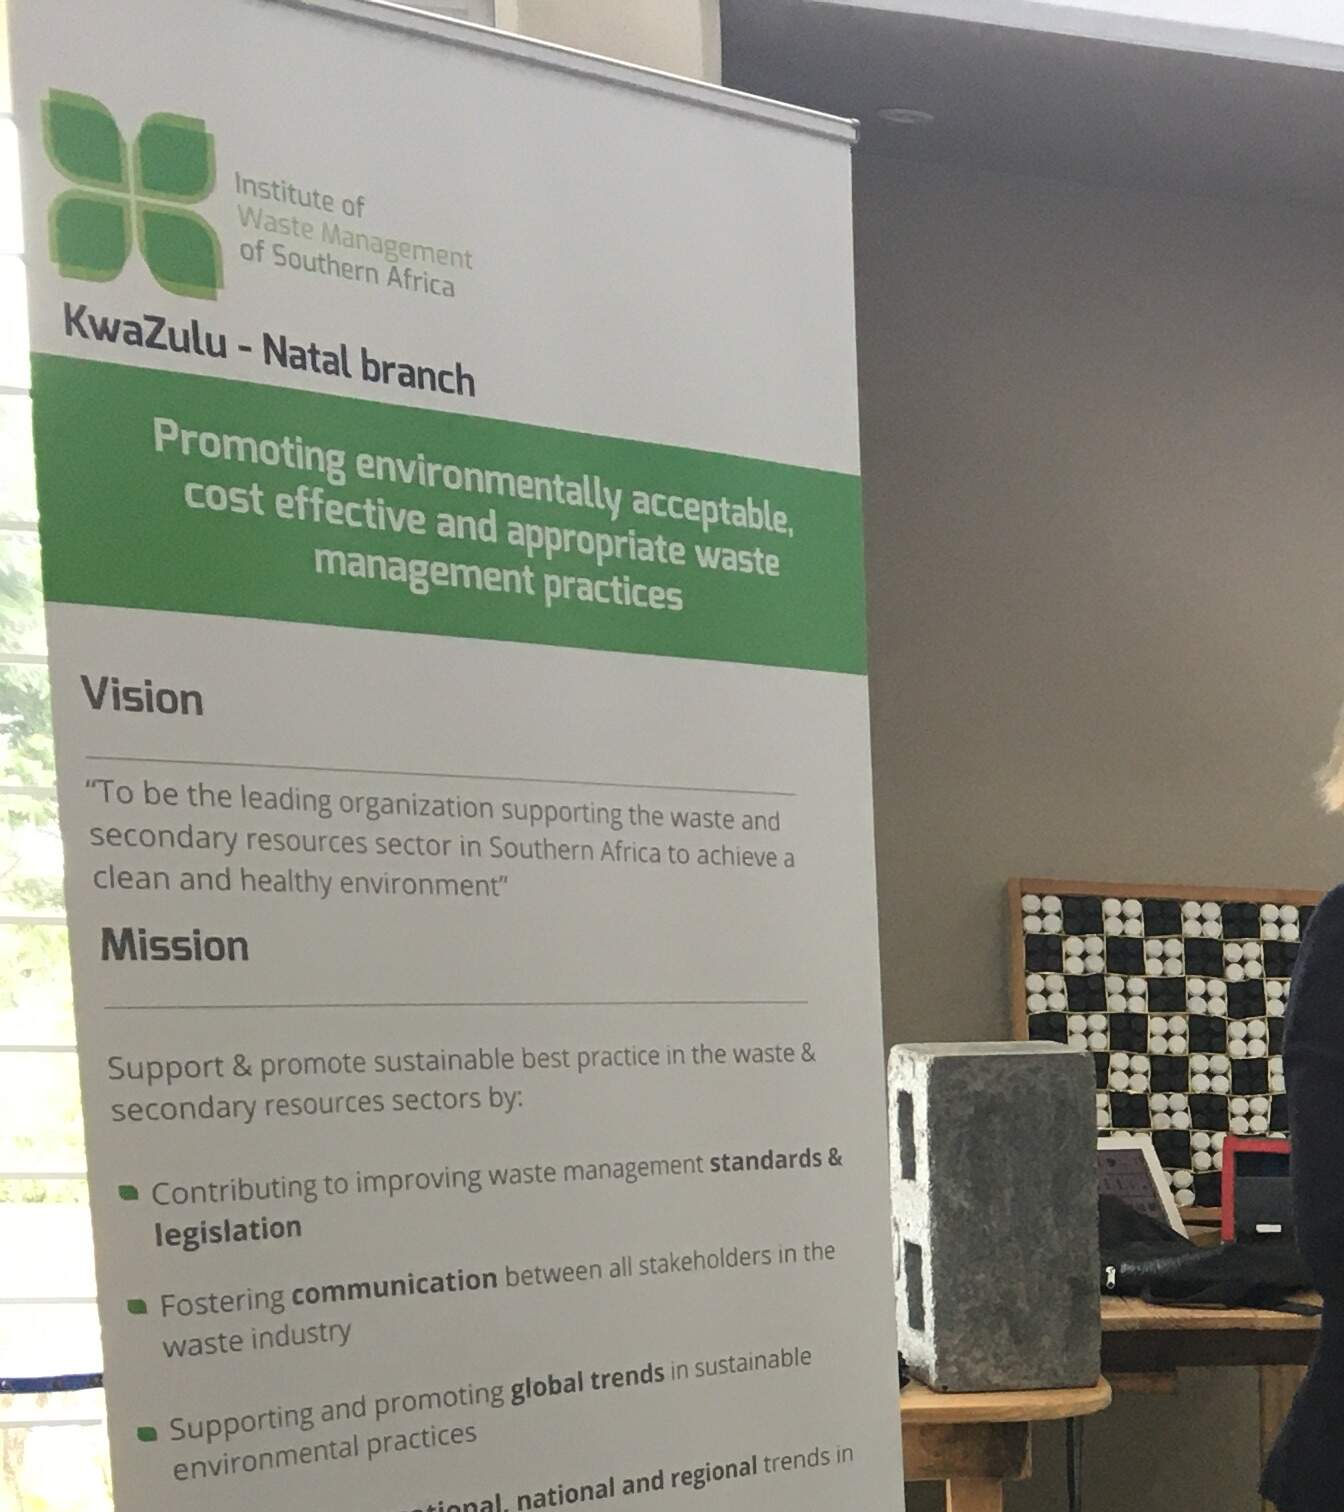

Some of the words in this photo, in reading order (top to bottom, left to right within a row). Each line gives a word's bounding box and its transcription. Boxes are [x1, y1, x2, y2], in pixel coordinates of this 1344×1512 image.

[235, 171, 334, 213] Institute
[342, 195, 365, 218] of
[237, 204, 314, 241] Waste
[321, 221, 473, 270] Management
[240, 240, 265, 262] of
[272, 243, 379, 284] Southern
[387, 265, 455, 298] Africa
[64, 302, 227, 358] KwaZulu
[263, 333, 352, 378] Natal
[361, 347, 475, 397] branch
[154, 417, 346, 486] Promoting
[356, 453, 622, 521] environmentally
[633, 491, 793, 537] acceptable,
[185, 483, 265, 516] cost
[275, 490, 426, 535] effective
[437, 510, 497, 543] and
[508, 521, 686, 567] appropriate
[695, 545, 779, 576] waste
[315, 549, 535, 595] management
[544, 574, 683, 611] practices
[80, 675, 203, 715] Vision
[102, 927, 249, 961] Mission
